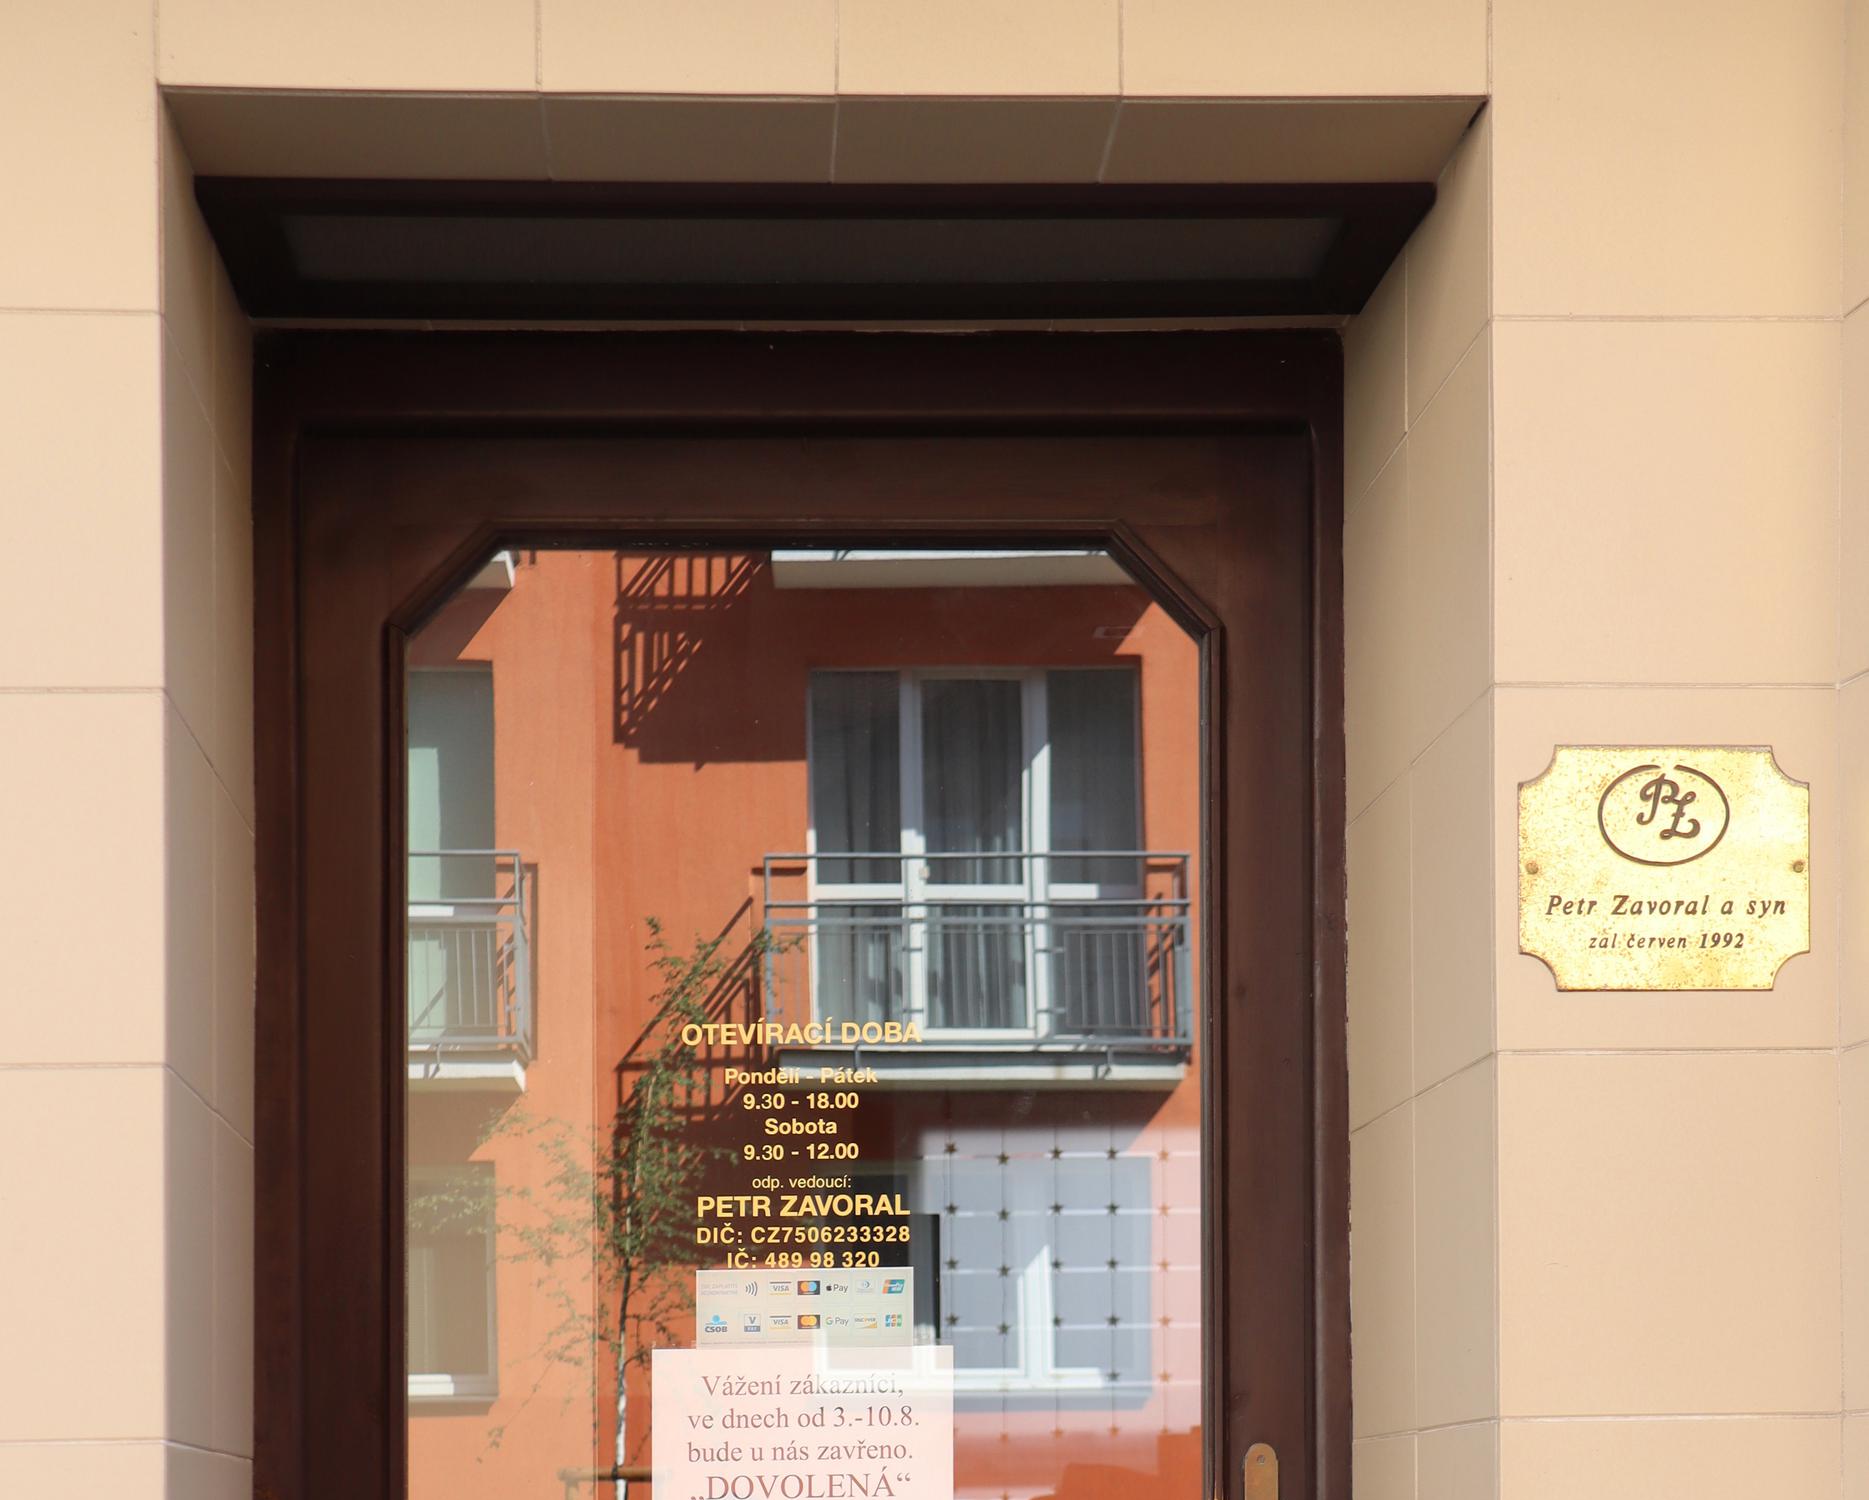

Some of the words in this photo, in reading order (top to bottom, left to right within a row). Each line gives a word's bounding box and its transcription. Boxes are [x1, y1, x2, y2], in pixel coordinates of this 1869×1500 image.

[1545, 894, 1598, 916] Petr
[1611, 894, 1709, 916] Zavoral
[1720, 900, 1733, 915] a
[1746, 899, 1786, 918] syn
[1626, 933, 1687, 950] červen
[1698, 933, 1745, 950] 1992
[681, 1017, 834, 1045] OTEVÍRACÍ
[841, 1021, 922, 1044] DOBA
[724, 1066, 800, 1085] Pondělí
[820, 1066, 878, 1085] Pátek
[743, 1093, 785, 1110] 9.30
[806, 1092, 859, 1110] 18.00
[764, 1118, 838, 1135] Sobota
[743, 1144, 785, 1161] 9.30
[806, 1143, 859, 1160] 12.00
[751, 1175, 784, 1191] odp.
[789, 1174, 852, 1189] vedoucí:
[697, 1195, 771, 1218] PETR
[780, 1194, 911, 1217] ZAVORAL
[696, 1222, 743, 1244] DIČ:
[750, 1225, 911, 1244] CZ7506233328
[727, 1248, 757, 1269] IČ:
[764, 1251, 803, 1269] 489
[810, 1251, 835, 1268] 98
[841, 1250, 880, 1268] 320
[833, 1284, 849, 1293] Pay
[835, 1317, 849, 1326] Pay
[701, 1373, 782, 1396] Vážení
[789, 1372, 904, 1398] zákazníci,
[688, 1414, 714, 1429] ve
[722, 1407, 790, 1429] dnech
[797, 1407, 825, 1428] od
[833, 1405, 920, 1428] 3.-10.8.
[688, 1441, 743, 1463] bude
[751, 1447, 764, 1462] u
[772, 1440, 809, 1461] nás
[817, 1440, 914, 1461] zavřeno.
